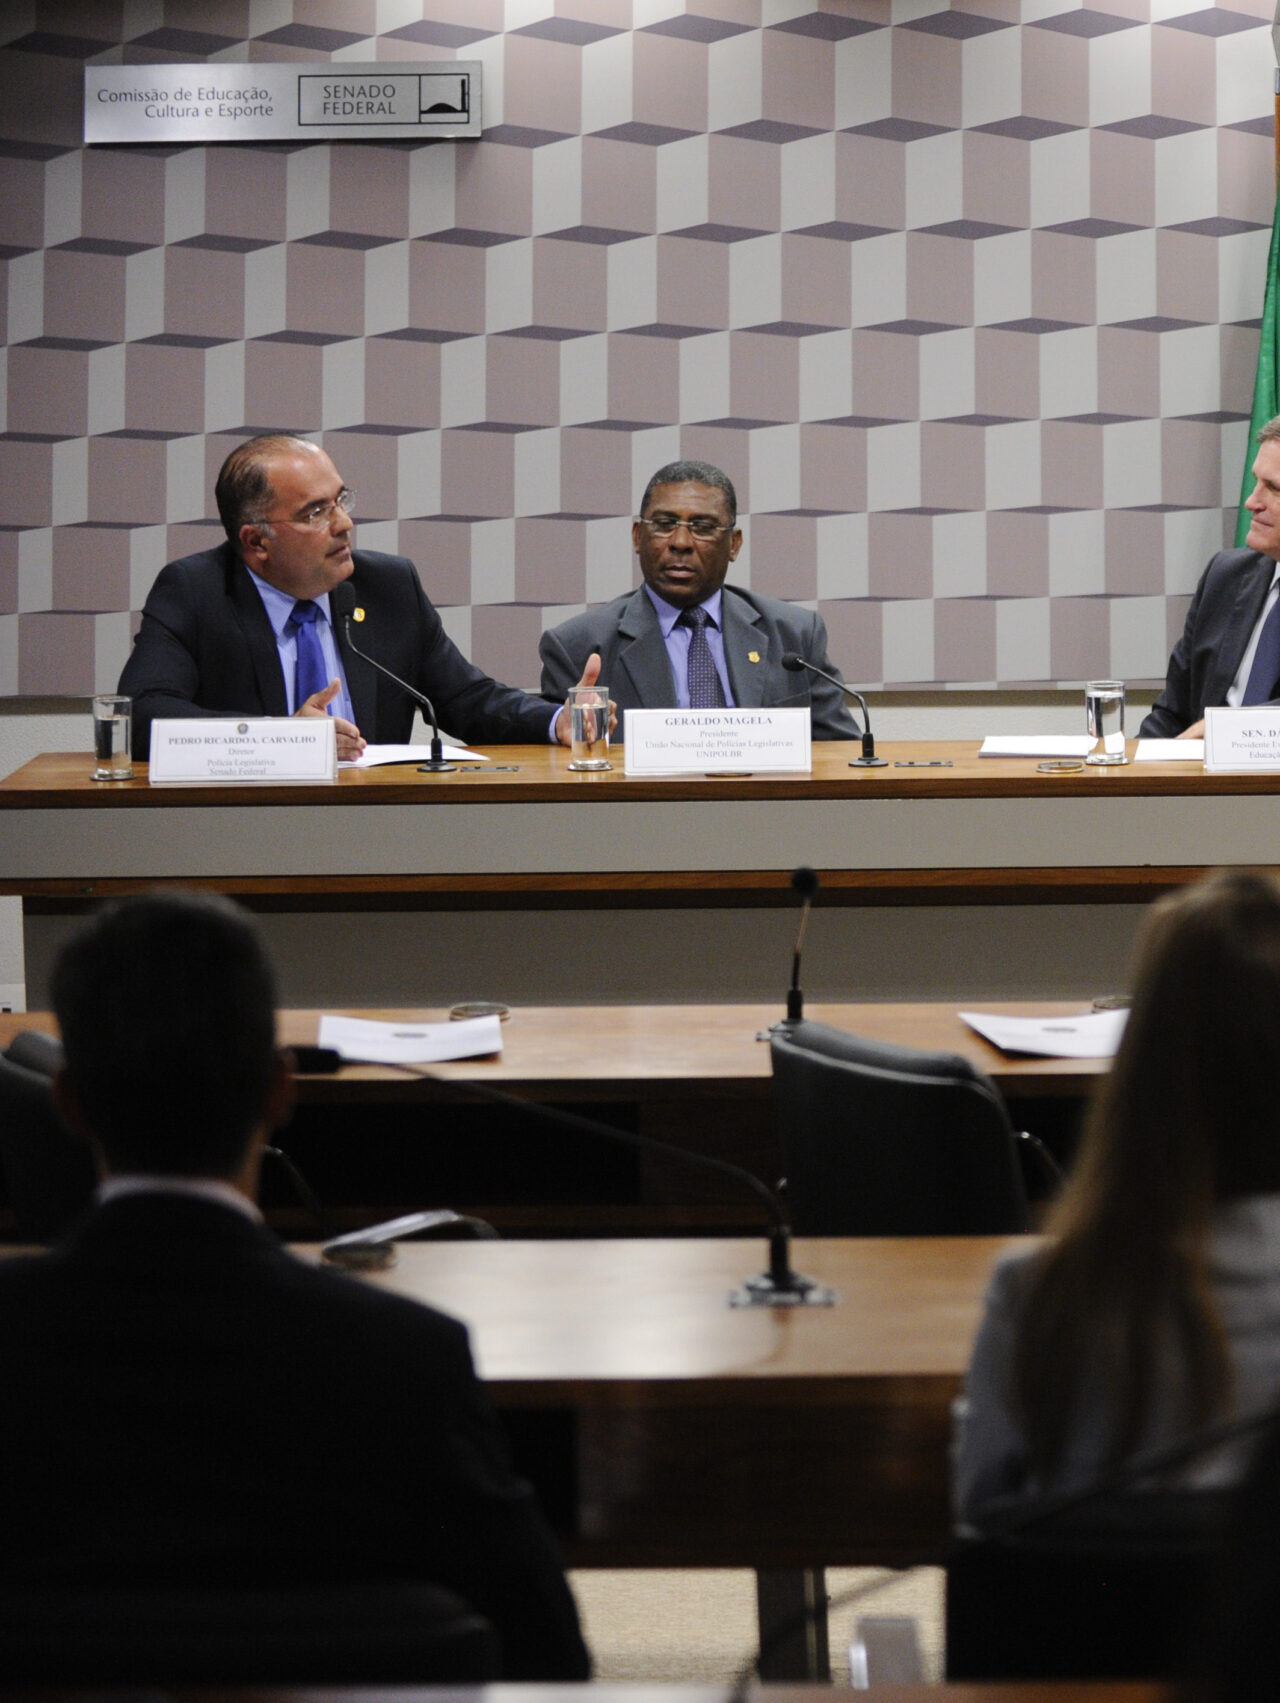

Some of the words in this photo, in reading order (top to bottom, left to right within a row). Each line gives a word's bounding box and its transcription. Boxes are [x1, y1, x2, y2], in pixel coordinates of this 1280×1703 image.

[97, 87, 168, 103] Comissão
[173, 88, 192, 101] de
[197, 87, 273, 103] Educação,
[323, 84, 396, 99] SENADO
[145, 104, 199, 119] Cultura
[205, 107, 213, 118] e
[219, 103, 273, 120] Esporte
[323, 101, 396, 115] FEDERAL
[665, 716, 720, 726] GERALDO
[723, 716, 773, 725] MAGELA
[1241, 729, 1266, 738] SEN.
[168, 736, 201, 745] PEDRO
[261, 736, 317, 744] CARVALHO
[705, 740, 715, 749] de
